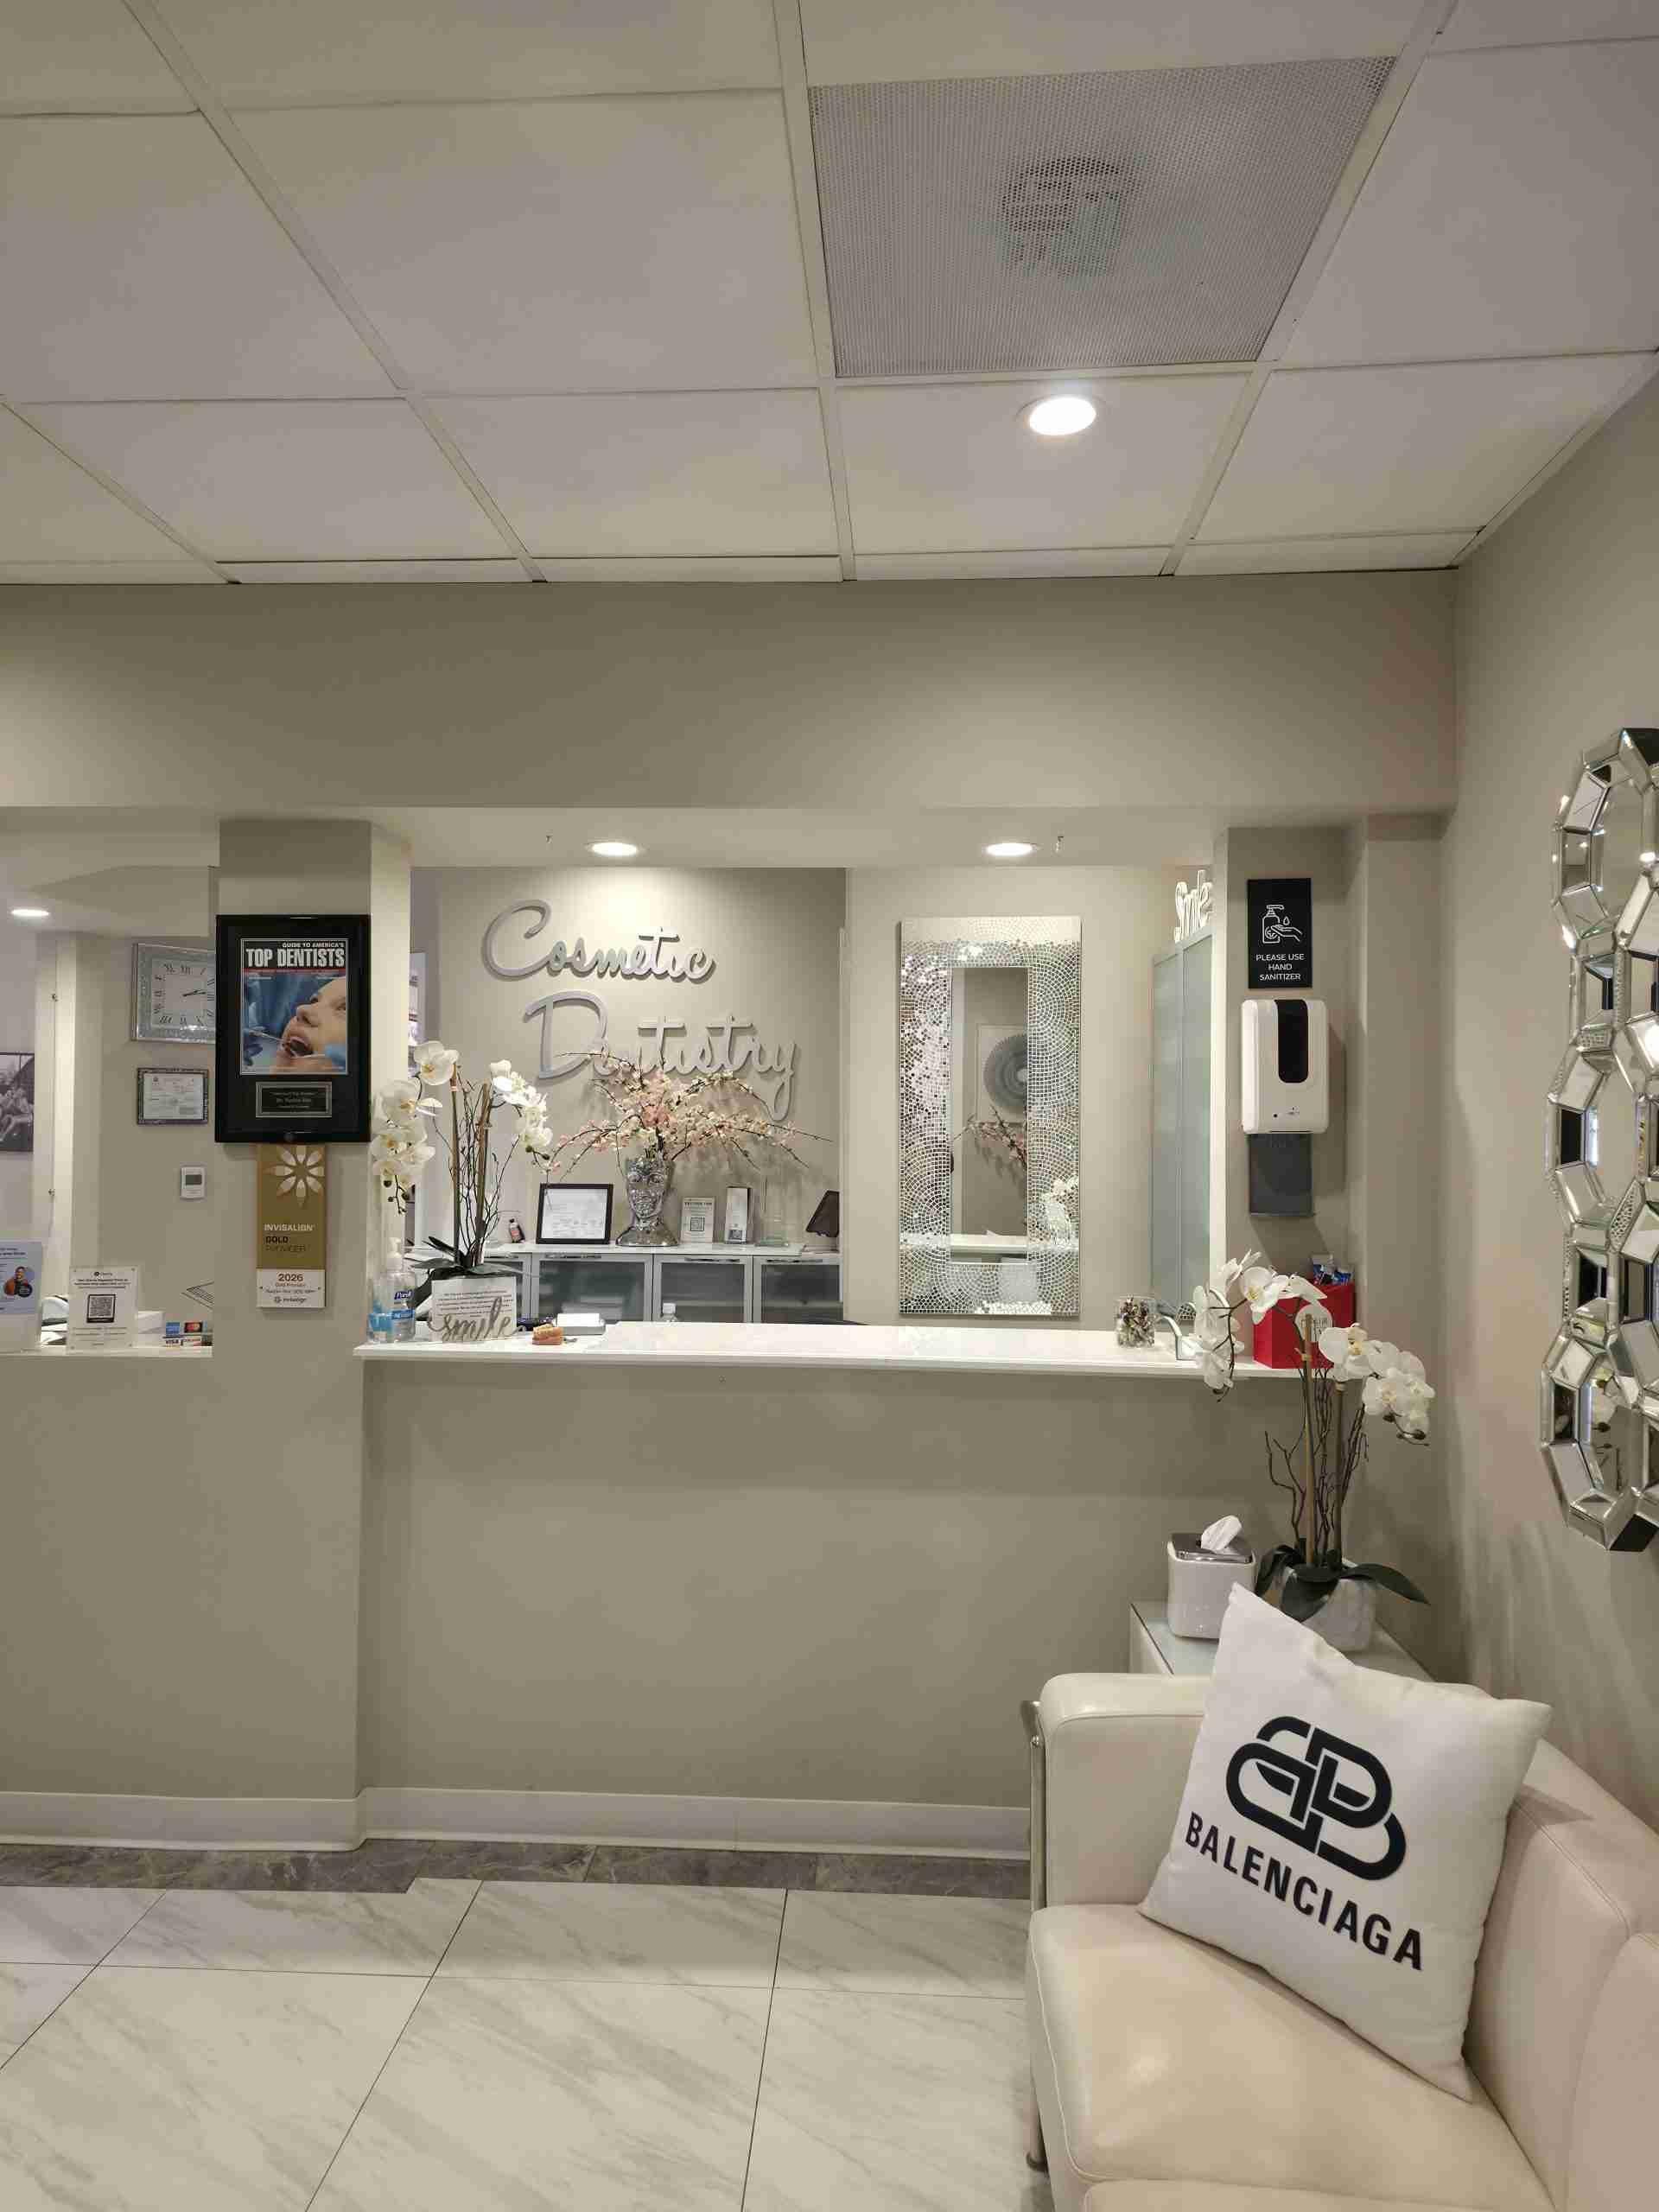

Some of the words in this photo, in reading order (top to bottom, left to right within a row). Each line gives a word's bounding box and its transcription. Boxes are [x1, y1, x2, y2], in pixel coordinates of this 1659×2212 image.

[483, 899, 716, 982] Cosmetic
[245, 949, 274, 968] TOP
[276, 949, 346, 968] DENTISTS
[1255, 953, 1287, 962] PLEASE
[1259, 973, 1301, 982] SANITIZER
[1185, 1810, 1424, 1971] BALENCIAGA
